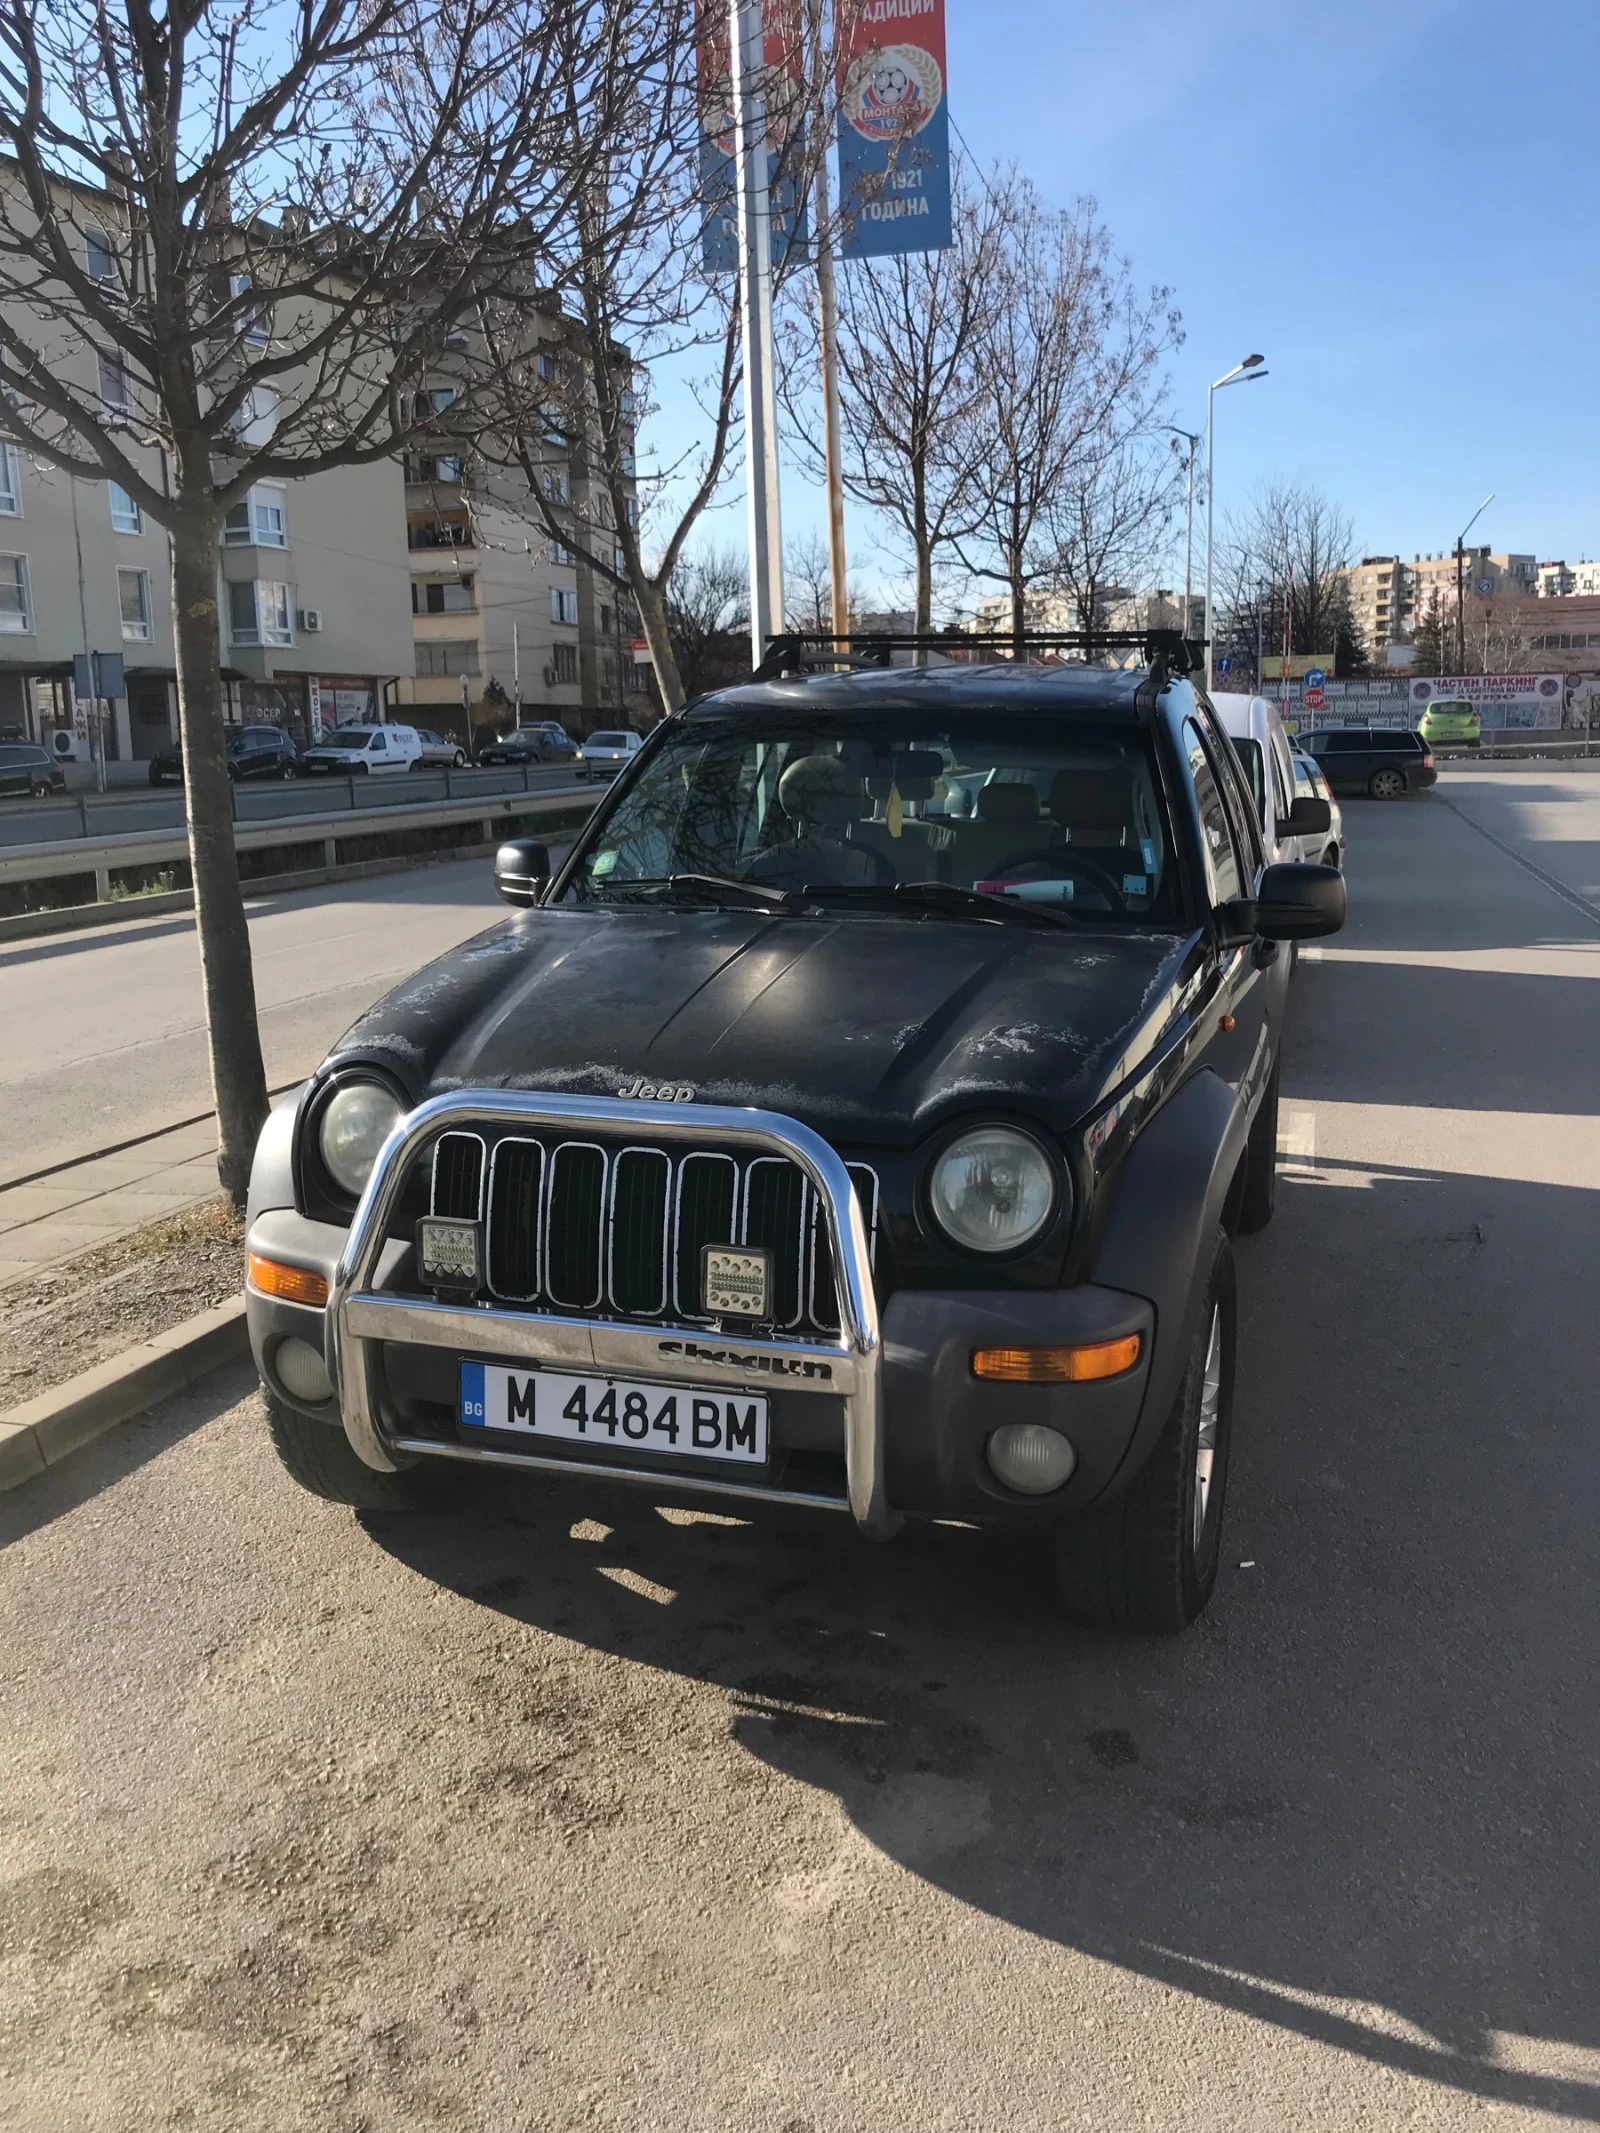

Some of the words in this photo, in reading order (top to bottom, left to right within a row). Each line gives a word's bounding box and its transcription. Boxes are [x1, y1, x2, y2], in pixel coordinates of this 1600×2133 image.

[861, 197, 930, 221] ГОДИНА
[1433, 678, 1480, 688] ЧАСТЕН
[1483, 676, 1539, 687] ПАРКИНГ
[1305, 694, 1324, 704] STOP
[618, 1079, 695, 1103] Jeep
[658, 1341, 832, 1381] Shogun
[464, 1400, 483, 1416] BG
